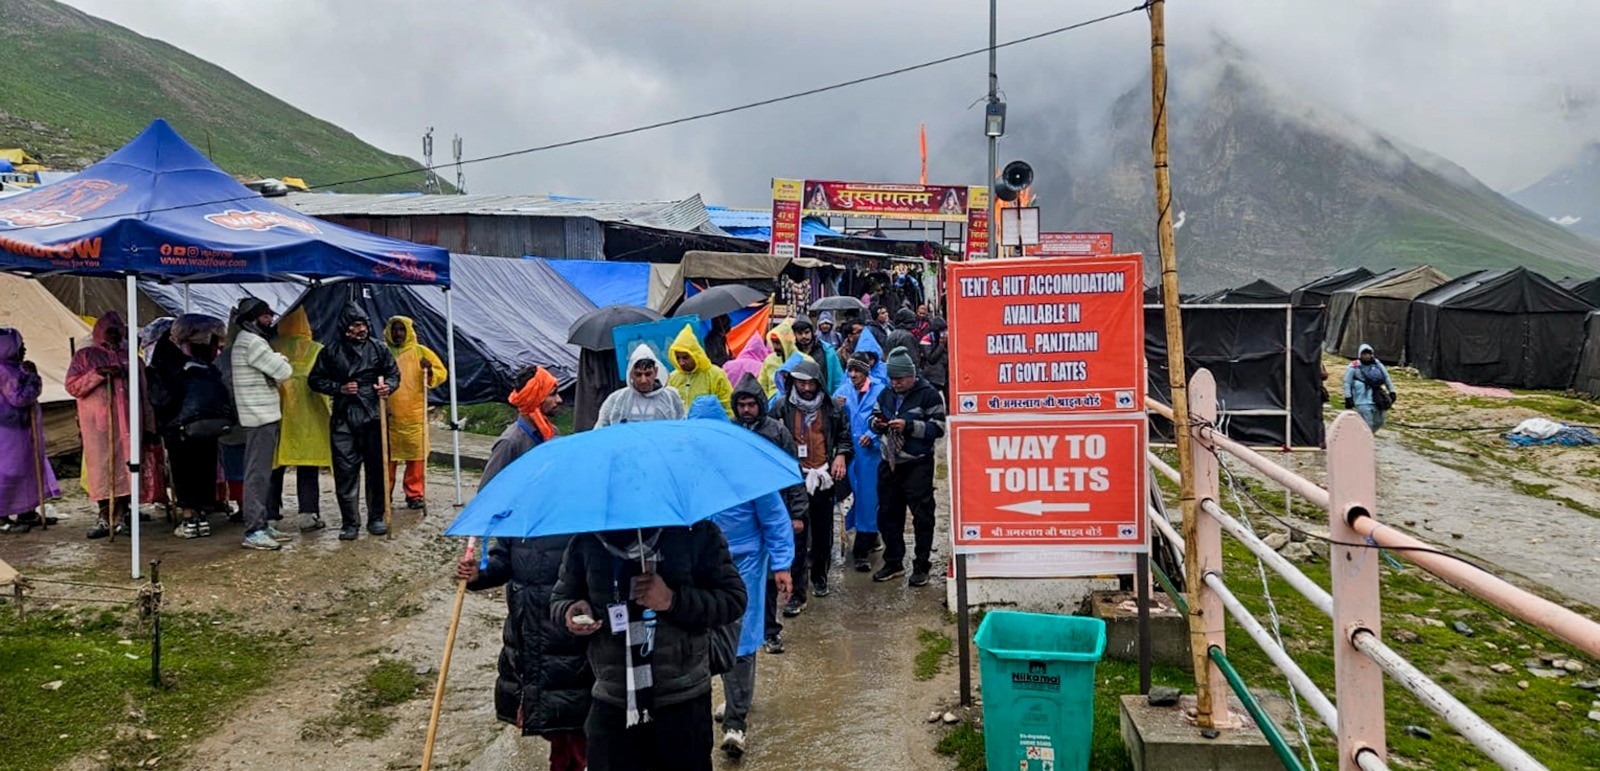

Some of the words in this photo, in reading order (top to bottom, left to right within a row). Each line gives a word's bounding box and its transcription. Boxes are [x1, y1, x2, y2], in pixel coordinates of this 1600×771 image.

[960, 277, 989, 297] TENT
[991, 280, 1000, 296] &
[1002, 275, 1027, 296] HUT
[1028, 272, 1125, 295] ACCOMODATION
[1003, 304, 1065, 325] AVAILABLE
[1067, 303, 1080, 323] IN
[987, 334, 1027, 355] BALTAL
[1035, 332, 1098, 353] PANJTARNI
[999, 362, 1014, 383] AT
[1015, 362, 1048, 382] GOVT.
[1051, 361, 1087, 381] RATES
[988, 396, 1000, 409] श्री
[1042, 395, 1055, 408] जी
[988, 435, 1059, 460] WAY
[1065, 434, 1106, 459] TO
[985, 467, 1110, 492] TOILETS
[991, 526, 1003, 537] श्री
[1045, 526, 1057, 537] जी
[1012, 672, 1061, 686] Nilkamal
